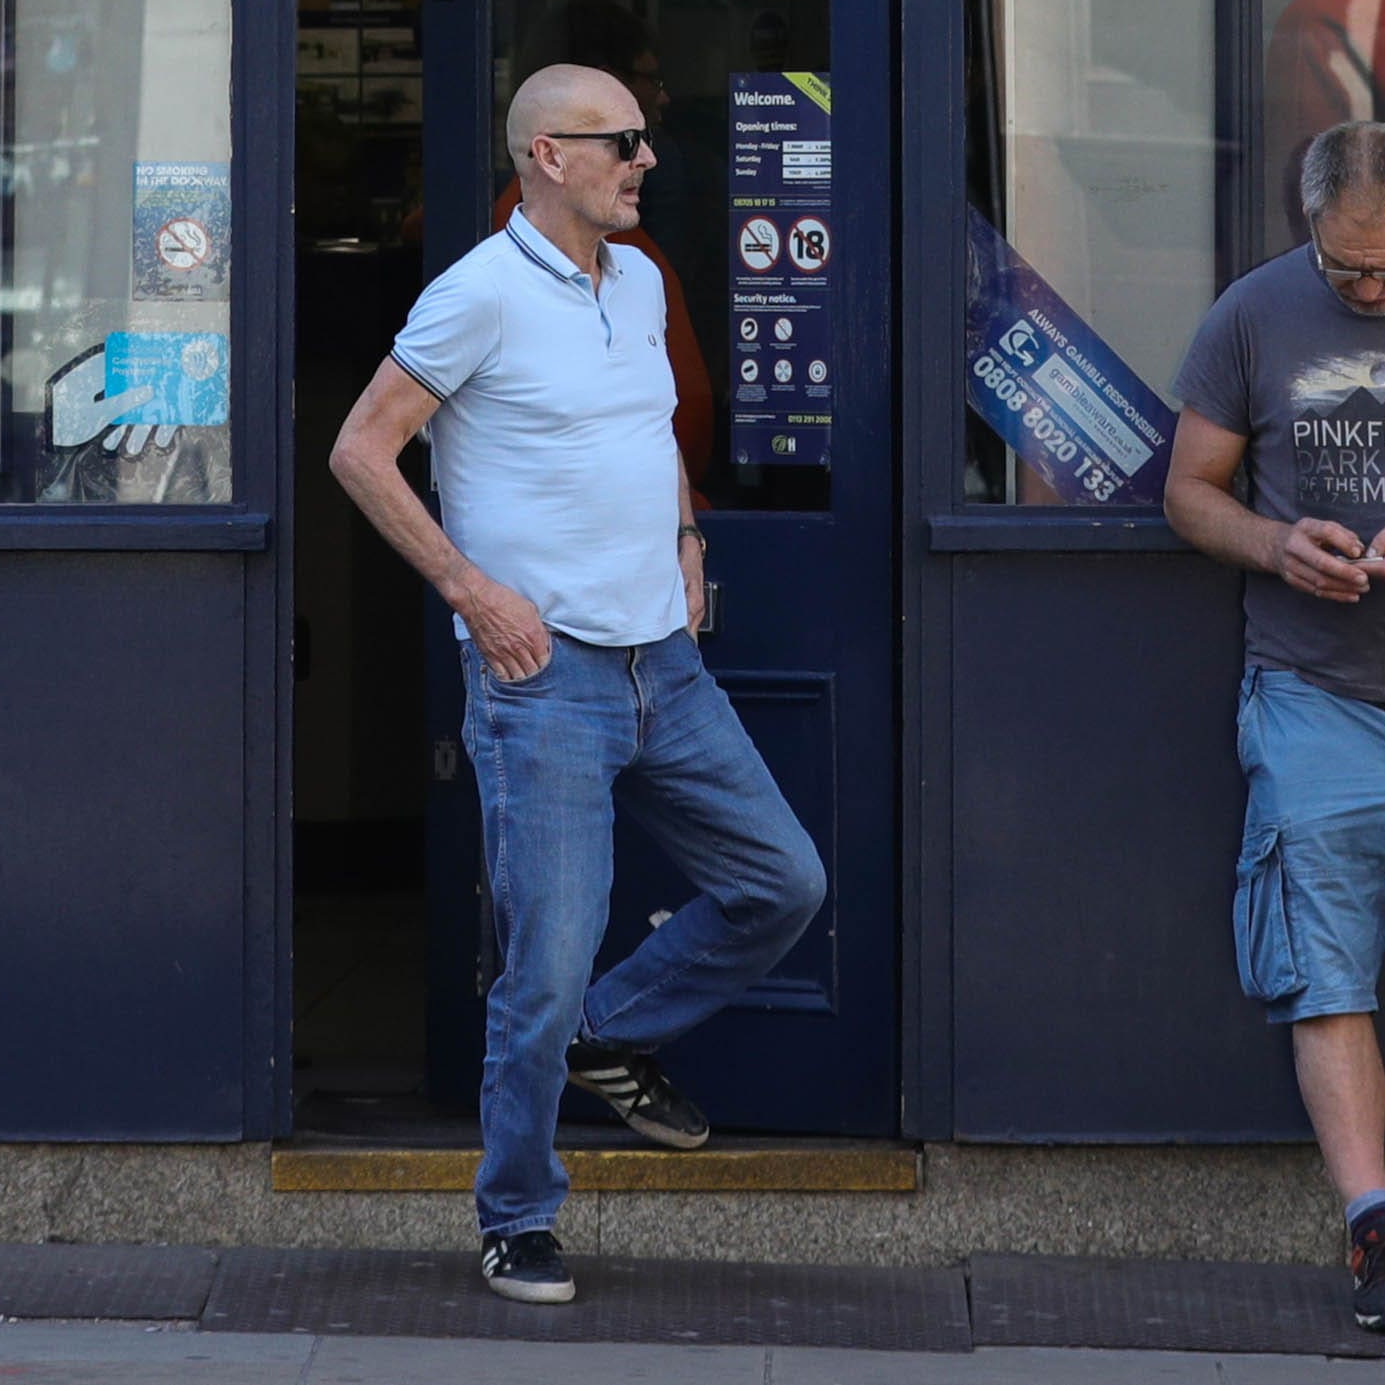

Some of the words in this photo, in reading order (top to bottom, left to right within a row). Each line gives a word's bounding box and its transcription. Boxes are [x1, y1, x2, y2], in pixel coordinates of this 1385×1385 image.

[734, 91, 796, 106] Welcome.
[735, 121, 770, 133] Opening
[136, 165, 154, 176] NO
[156, 165, 209, 176] SMOKING
[793, 230, 825, 260] 18
[733, 292, 767, 305] Security
[768, 292, 798, 304] notice.
[1027, 308, 1068, 349] ALWAYS
[1065, 344, 1109, 388] GAMBLE
[1102, 384, 1167, 448] RESPONSIBLY
[973, 355, 1027, 411] 0808
[1022, 406, 1077, 463] 8020
[1074, 458, 1116, 502] 133
[1296, 449, 1382, 475] DARK
[1324, 476, 1360, 492] THE
